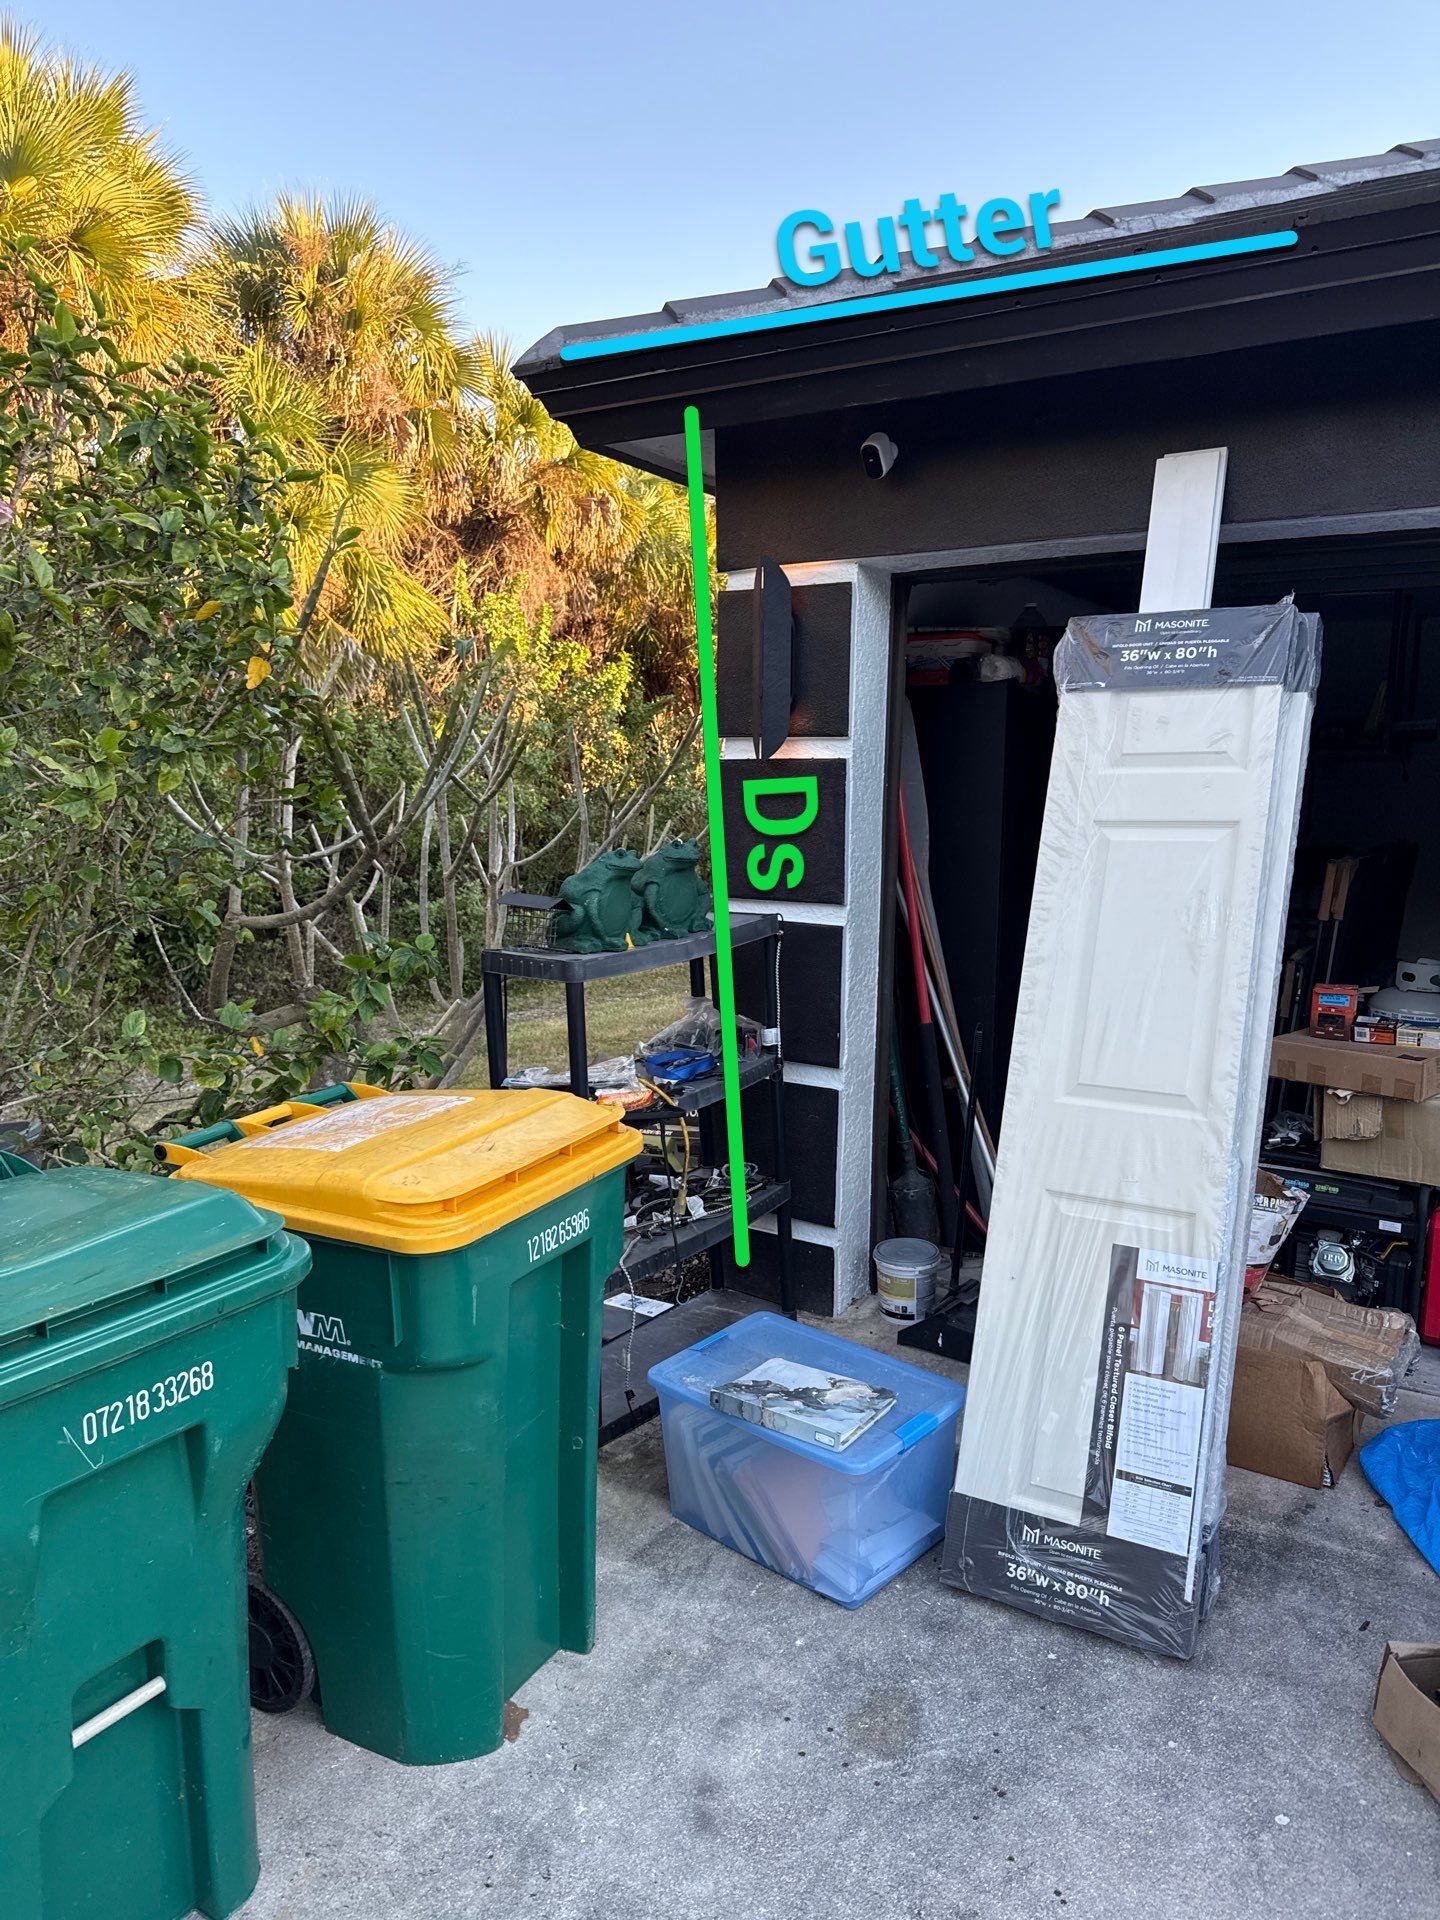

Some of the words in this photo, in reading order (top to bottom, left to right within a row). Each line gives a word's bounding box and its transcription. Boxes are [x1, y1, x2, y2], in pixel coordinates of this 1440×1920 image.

[1154, 619, 1210, 629] MASONITE
[527, 1208, 592, 1264] 1218265986
[1162, 1263, 1208, 1281] MASONITE
[1109, 1306, 1118, 1327] Puerta
[1107, 1328, 1115, 1354] plegable
[1115, 1334, 1124, 1357] Panel
[1102, 1370, 1110, 1389] closet
[1111, 1359, 1123, 1394] Textured
[81, 1361, 216, 1446] 0721833268
[1101, 1390, 1108, 1399] de
[1098, 1405, 1106, 1429] paneles
[1107, 1395, 1118, 1422] Closet
[1104, 1424, 1115, 1450] Bifold
[1044, 1534, 1102, 1560] MASONITE
[1052, 1581, 1061, 1592] x
[1074, 1573, 1094, 1583] PUERTA
[1010, 1583, 1020, 1592] Fits
[1020, 1586, 1041, 1598] Opening
[1053, 1597, 1067, 1605] Cabe
